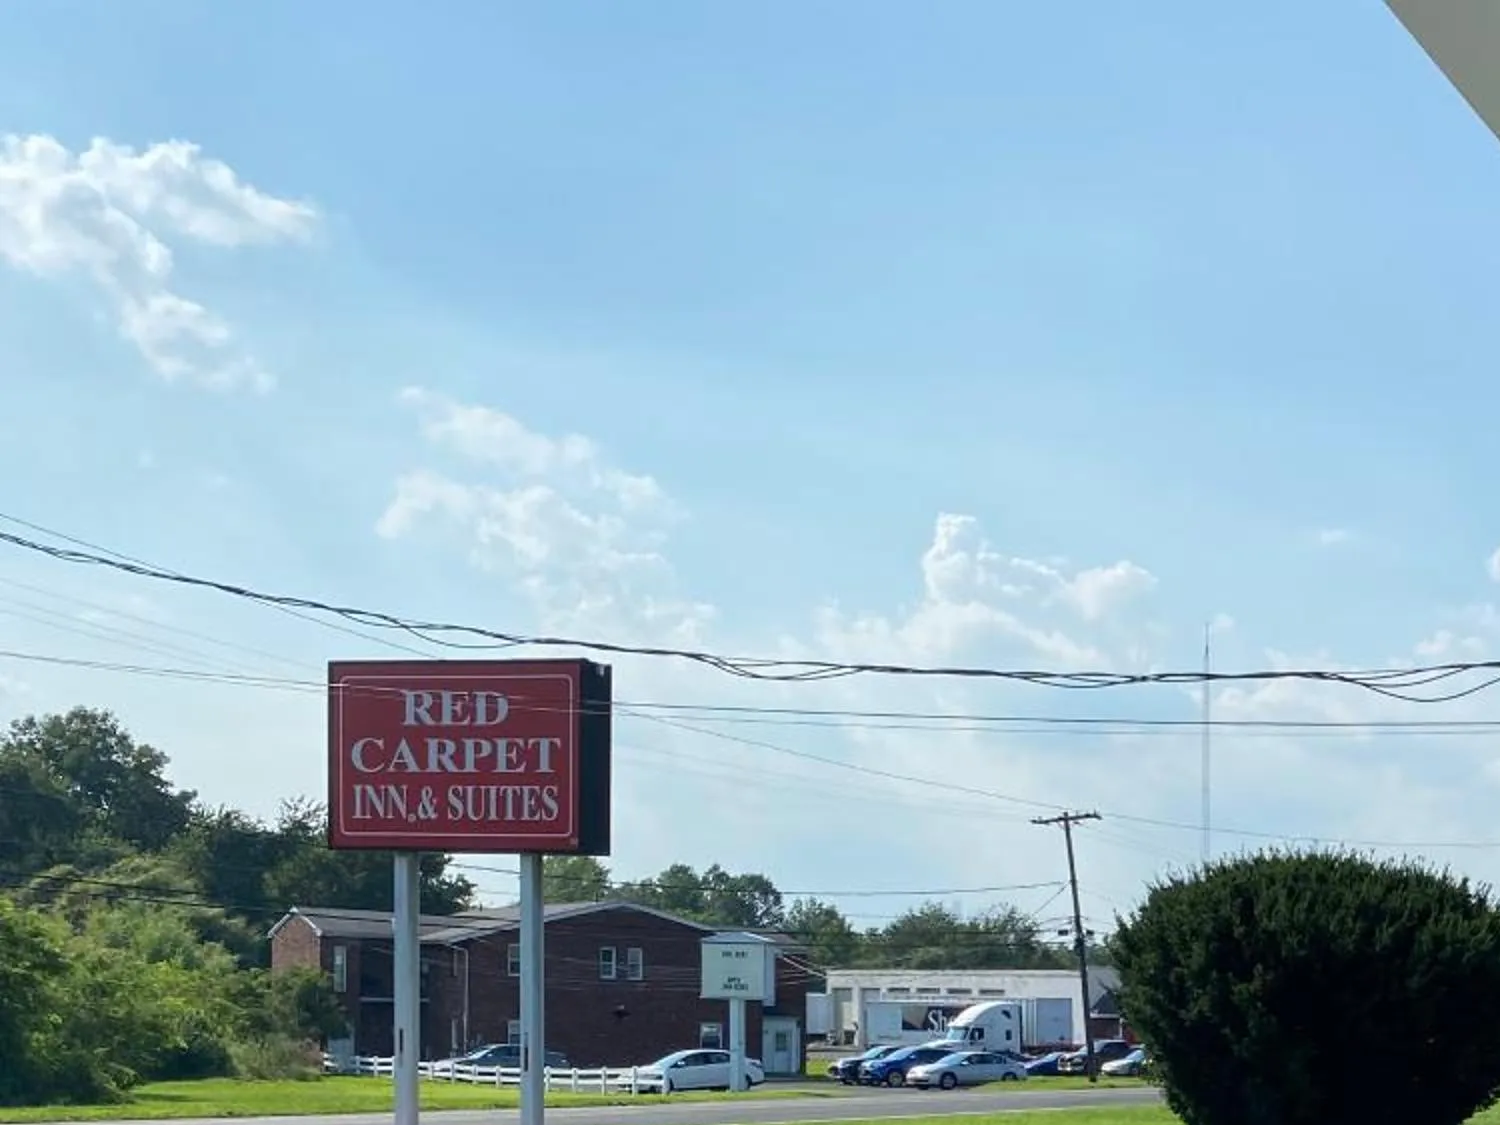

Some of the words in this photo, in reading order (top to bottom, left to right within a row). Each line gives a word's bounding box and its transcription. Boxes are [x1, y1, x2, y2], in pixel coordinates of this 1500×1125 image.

[402, 690, 509, 726] RED
[351, 738, 561, 773] CARPET
[447, 786, 559, 821] SUITES
